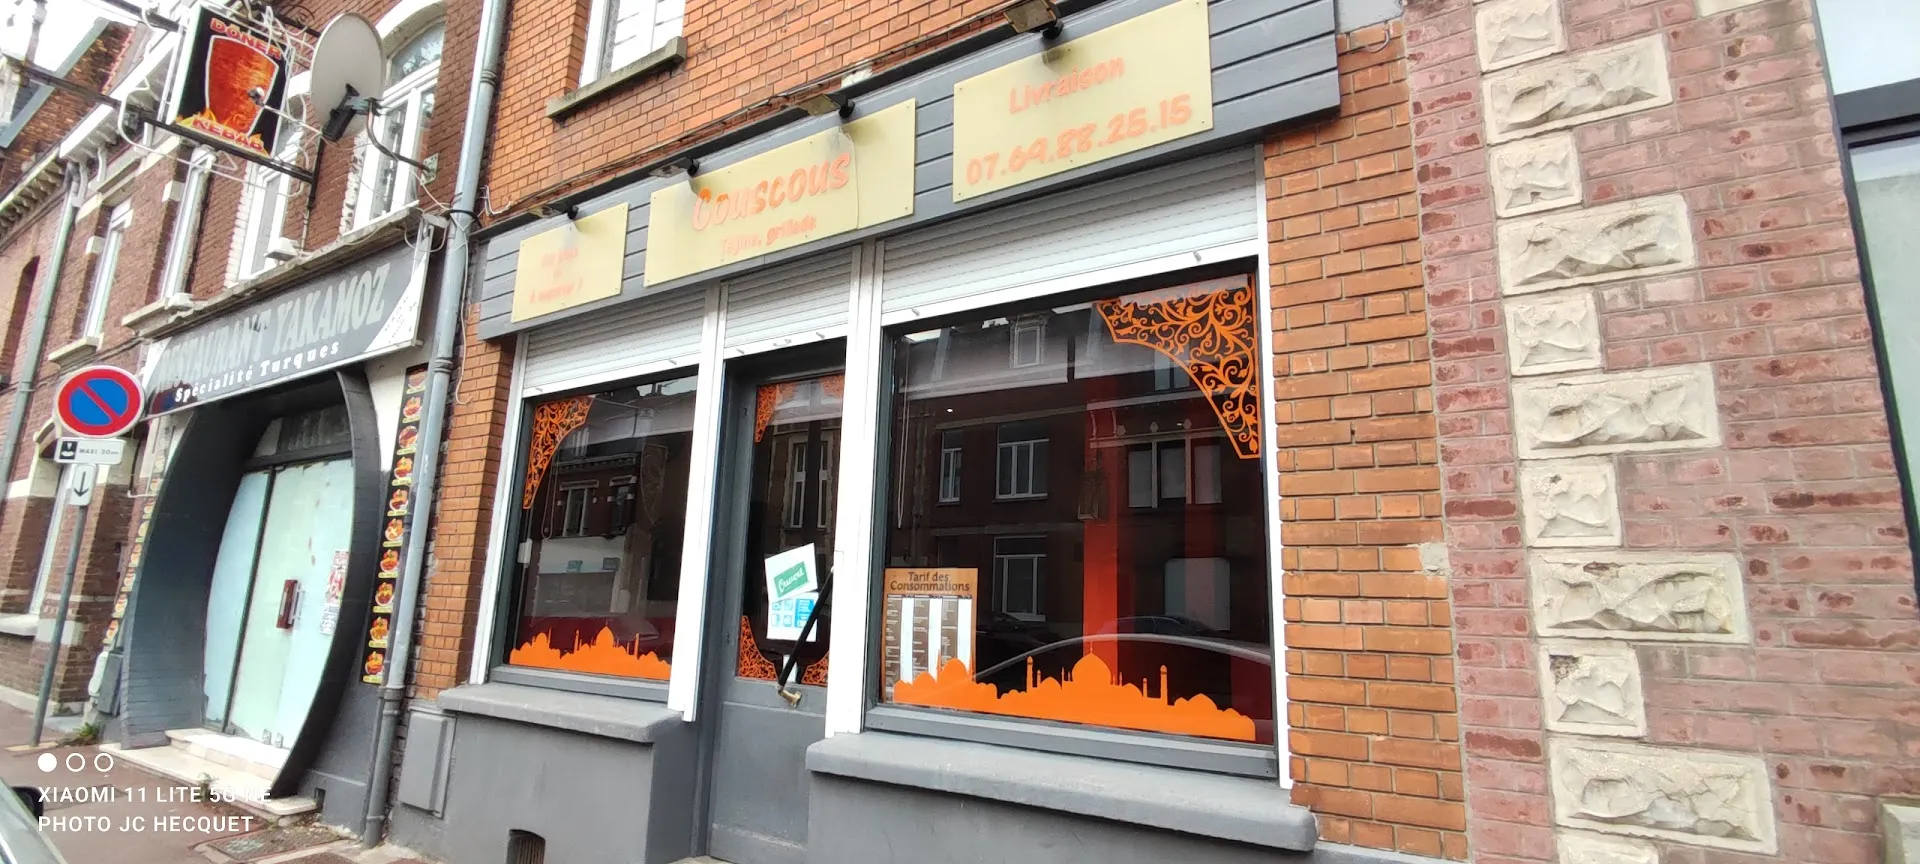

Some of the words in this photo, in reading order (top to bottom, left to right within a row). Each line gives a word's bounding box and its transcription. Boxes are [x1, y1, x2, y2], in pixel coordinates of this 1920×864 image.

[1008, 57, 1125, 114] Livraison
[191, 117, 264, 152] KEBAB
[272, 262, 392, 356] YAKAMOZ
[175, 367, 254, 403] Spécialité
[260, 341, 340, 377] Turques
[890, 580, 970, 592] Consommations
[908, 571, 931, 582] Tarif
[932, 571, 949, 582] des
